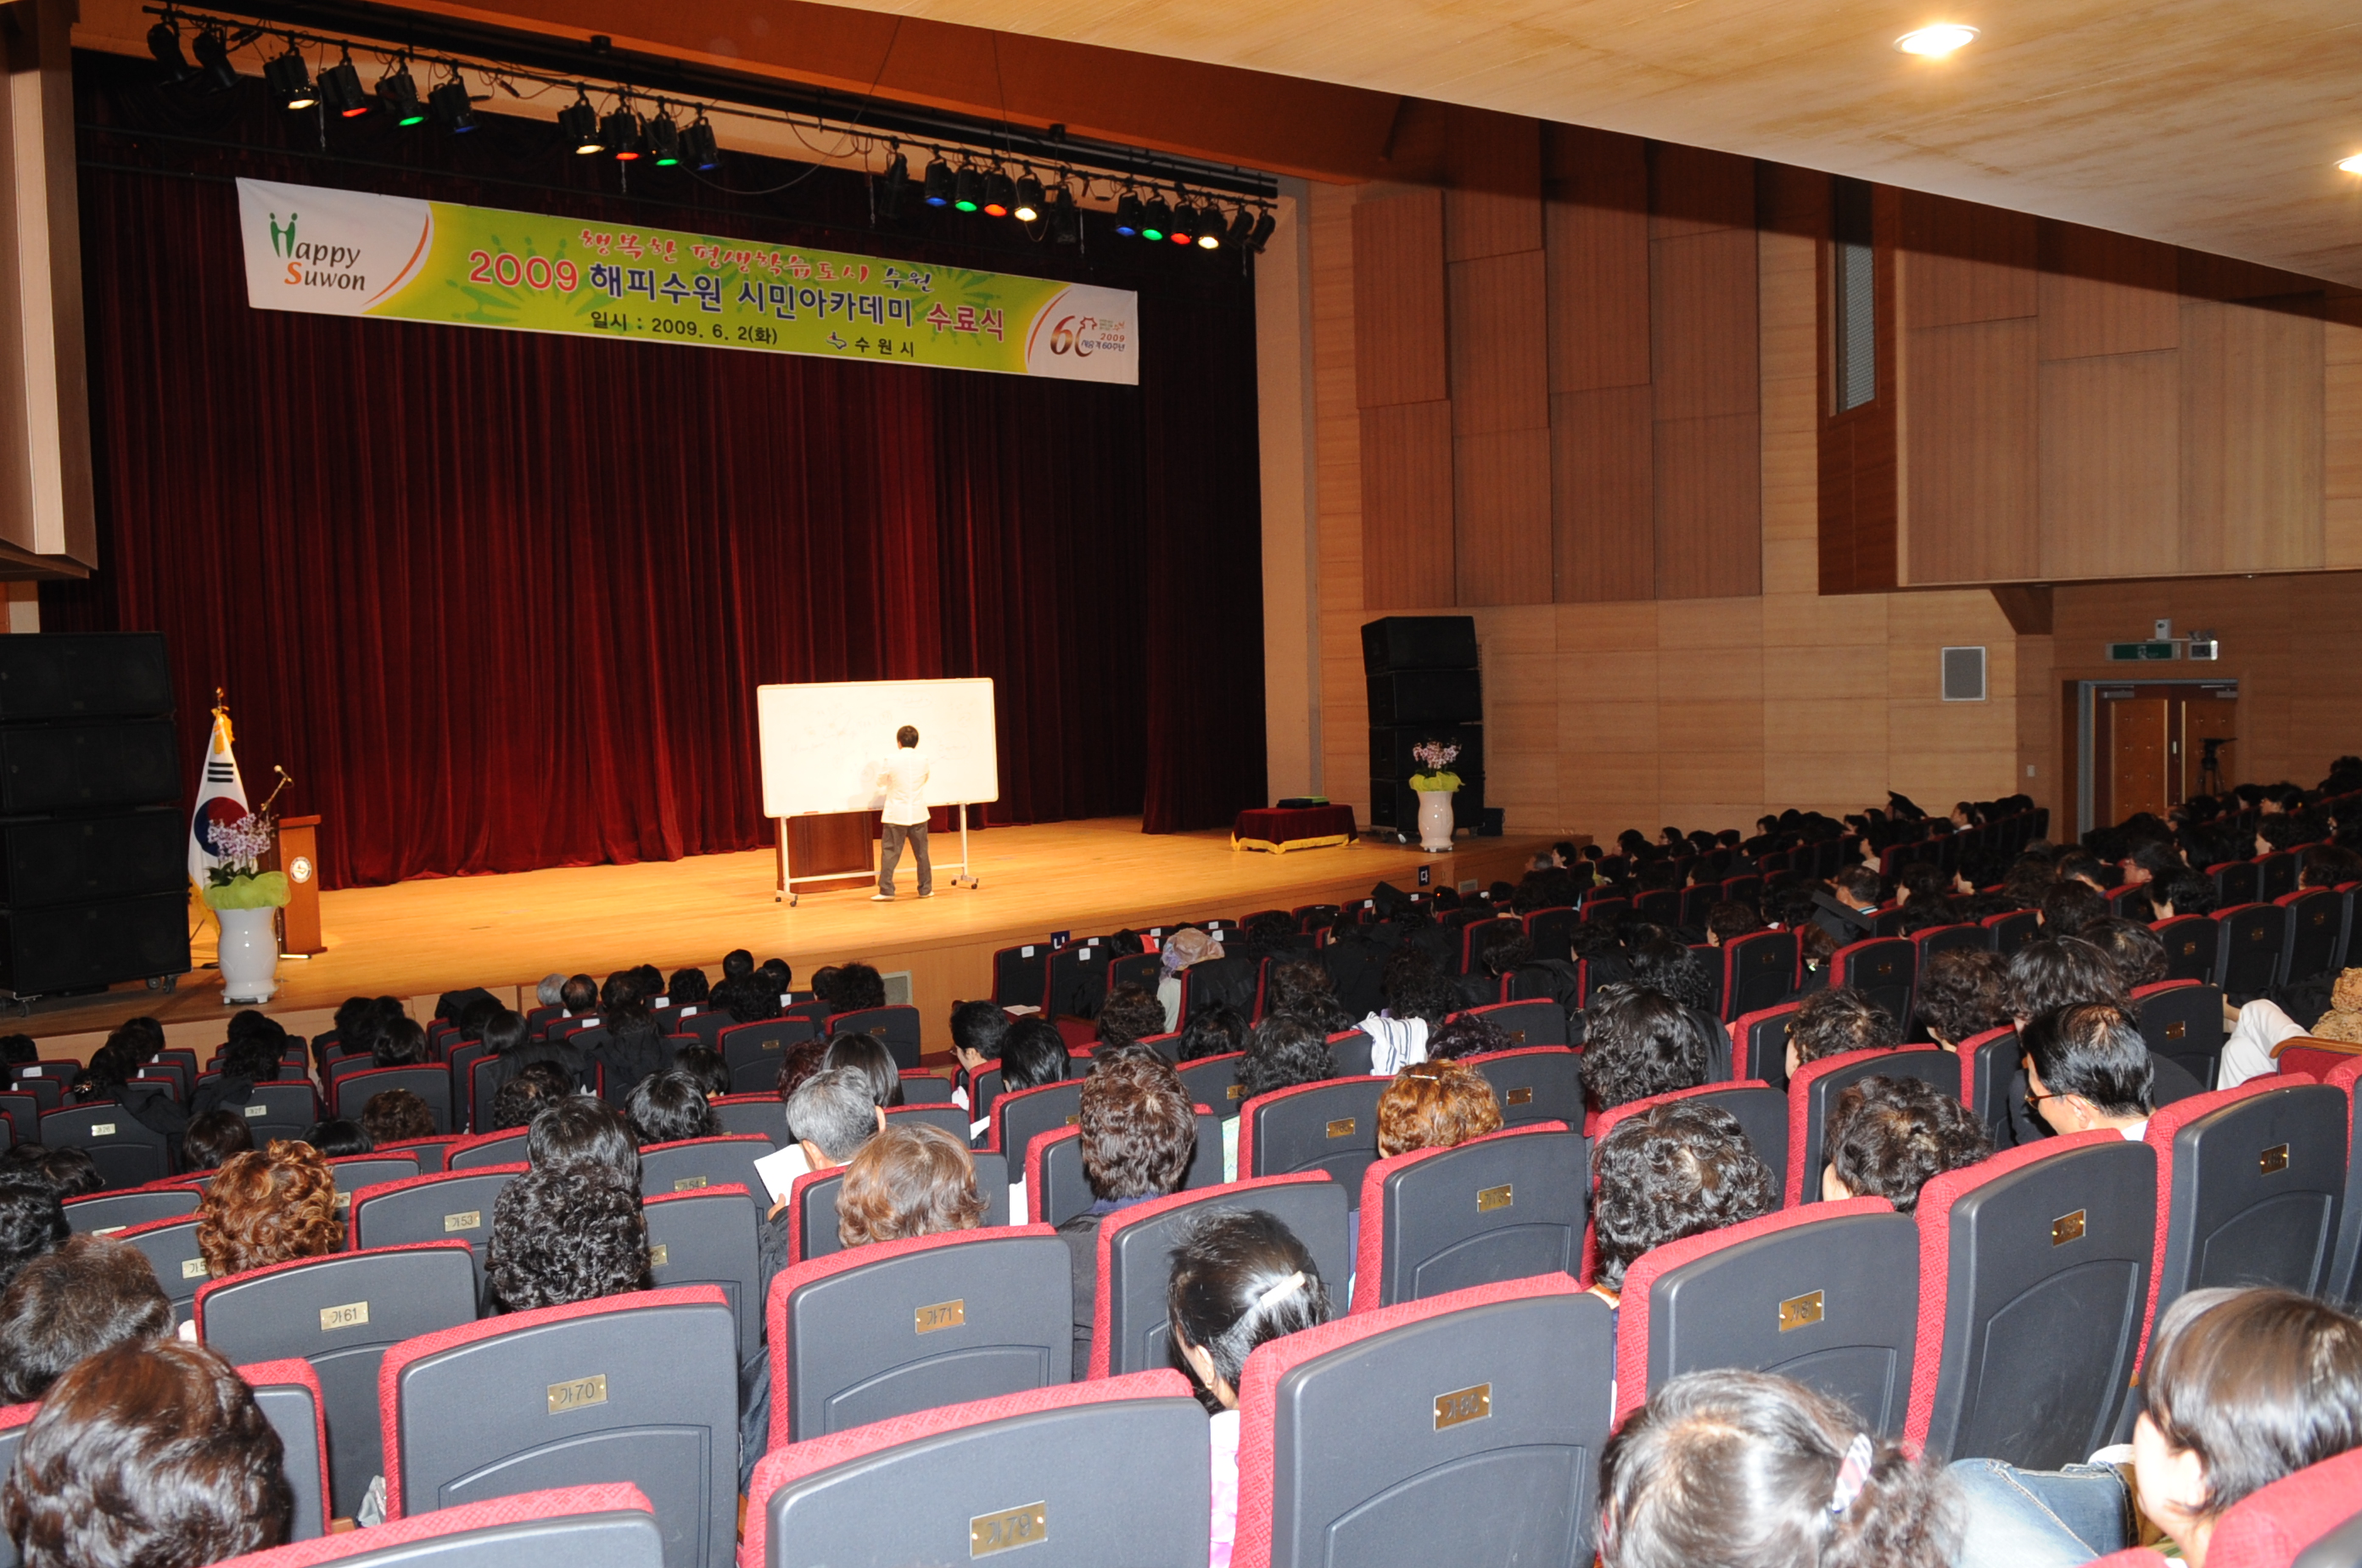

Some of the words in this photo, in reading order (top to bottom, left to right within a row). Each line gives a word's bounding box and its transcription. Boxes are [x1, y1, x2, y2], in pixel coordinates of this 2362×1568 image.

[270, 212, 361, 269] Happy
[579, 229, 678, 264] 행복한
[690, 244, 869, 283] 평생학습도시
[882, 266, 934, 293] 수원
[284, 261, 366, 291] Suwon
[469, 249, 579, 294] 2009
[589, 261, 723, 314] 해피수원
[736, 281, 913, 328] 시민아카데미
[926, 302, 1005, 343] 수료식
[590, 311, 627, 332] 일시
[1100, 333, 1126, 343] 2009
[451, 1215, 473, 1228] 가53
[190, 1261, 206, 1274] 가5
[332, 1308, 357, 1324] 가61
[926, 1306, 953, 1325] 가71
[560, 1380, 595, 1405] 가70
[1446, 1392, 1480, 1420] 가80
[986, 1513, 1032, 1545] 가79
